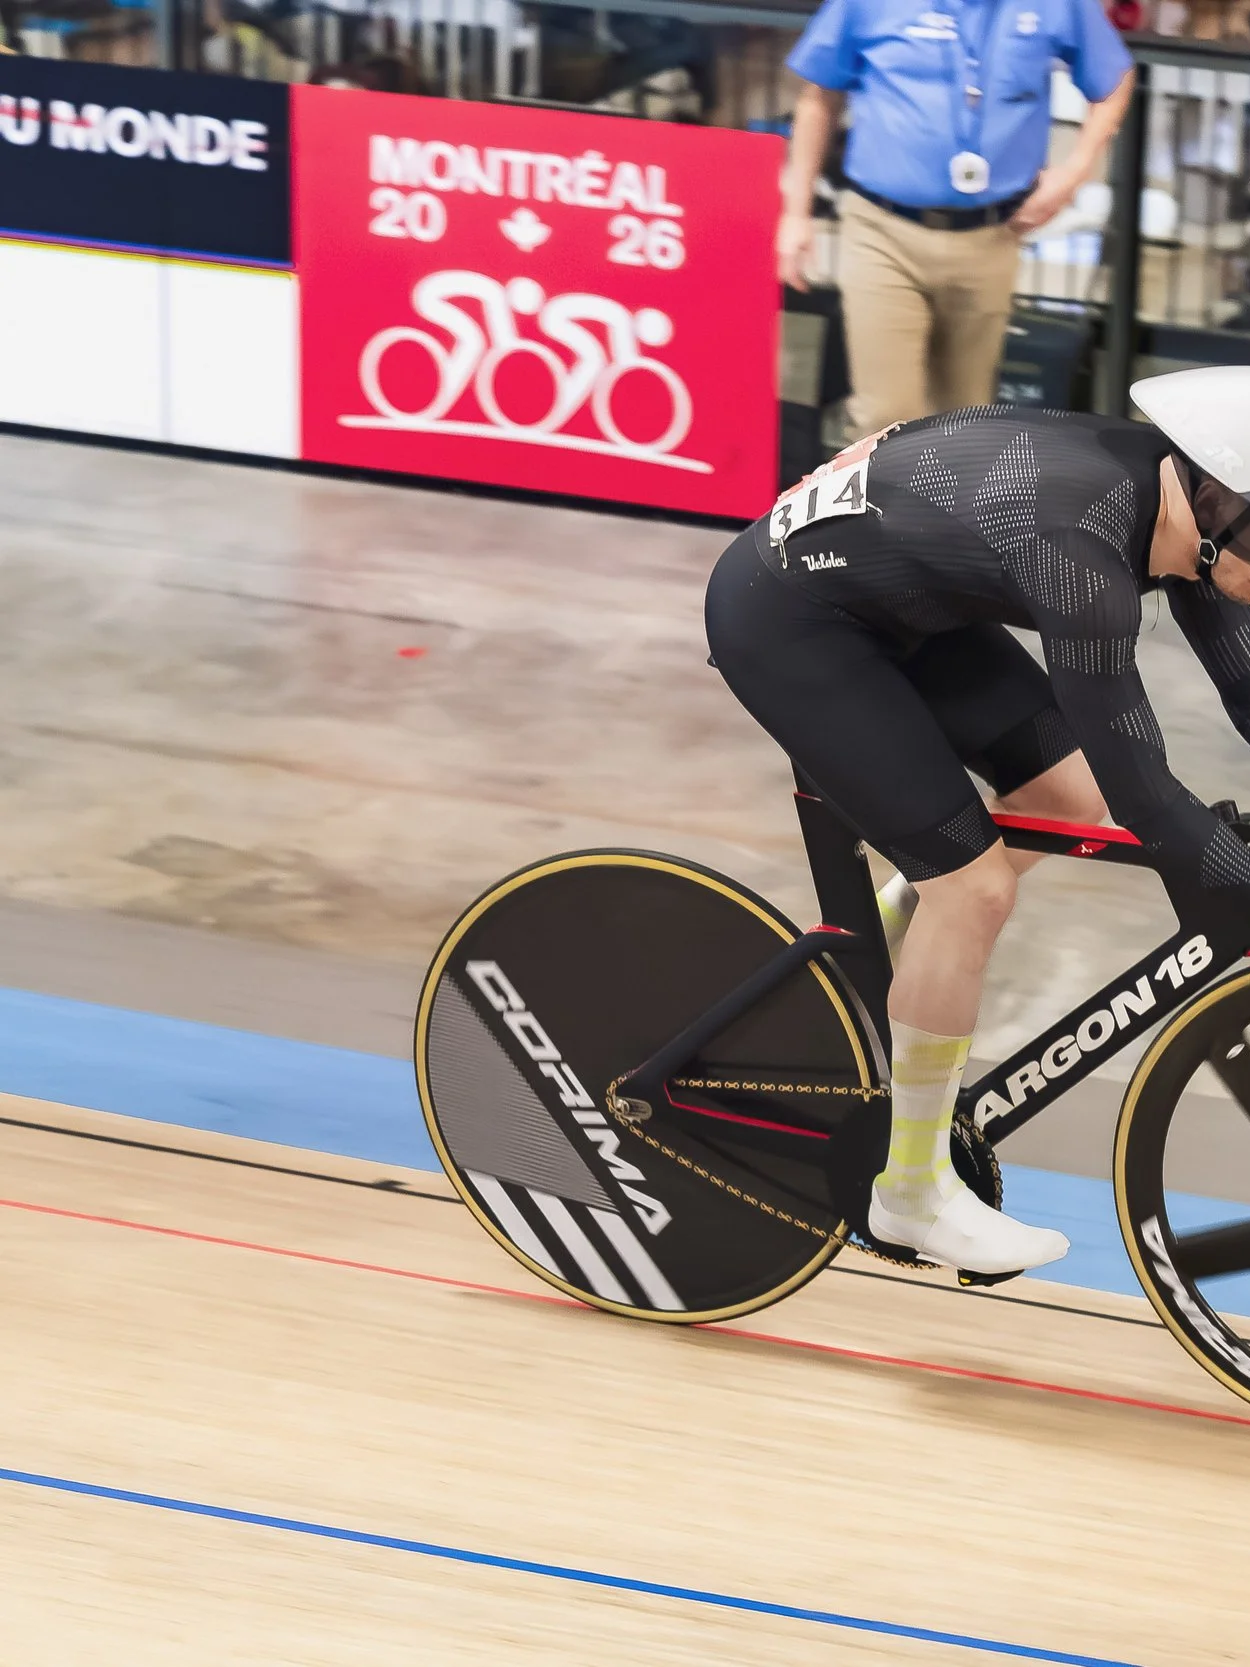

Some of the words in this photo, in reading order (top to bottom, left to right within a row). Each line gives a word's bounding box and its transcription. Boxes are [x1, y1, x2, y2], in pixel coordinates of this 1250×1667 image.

[49, 99, 269, 172] MONDE
[368, 134, 685, 217] MONTRÉAL
[368, 186, 448, 243] 20
[606, 213, 687, 270] 26
[771, 469, 865, 542] 314
[974, 974, 1158, 1133] ARGON
[1154, 934, 1214, 990] 18
[464, 959, 673, 1237] CORIMA
